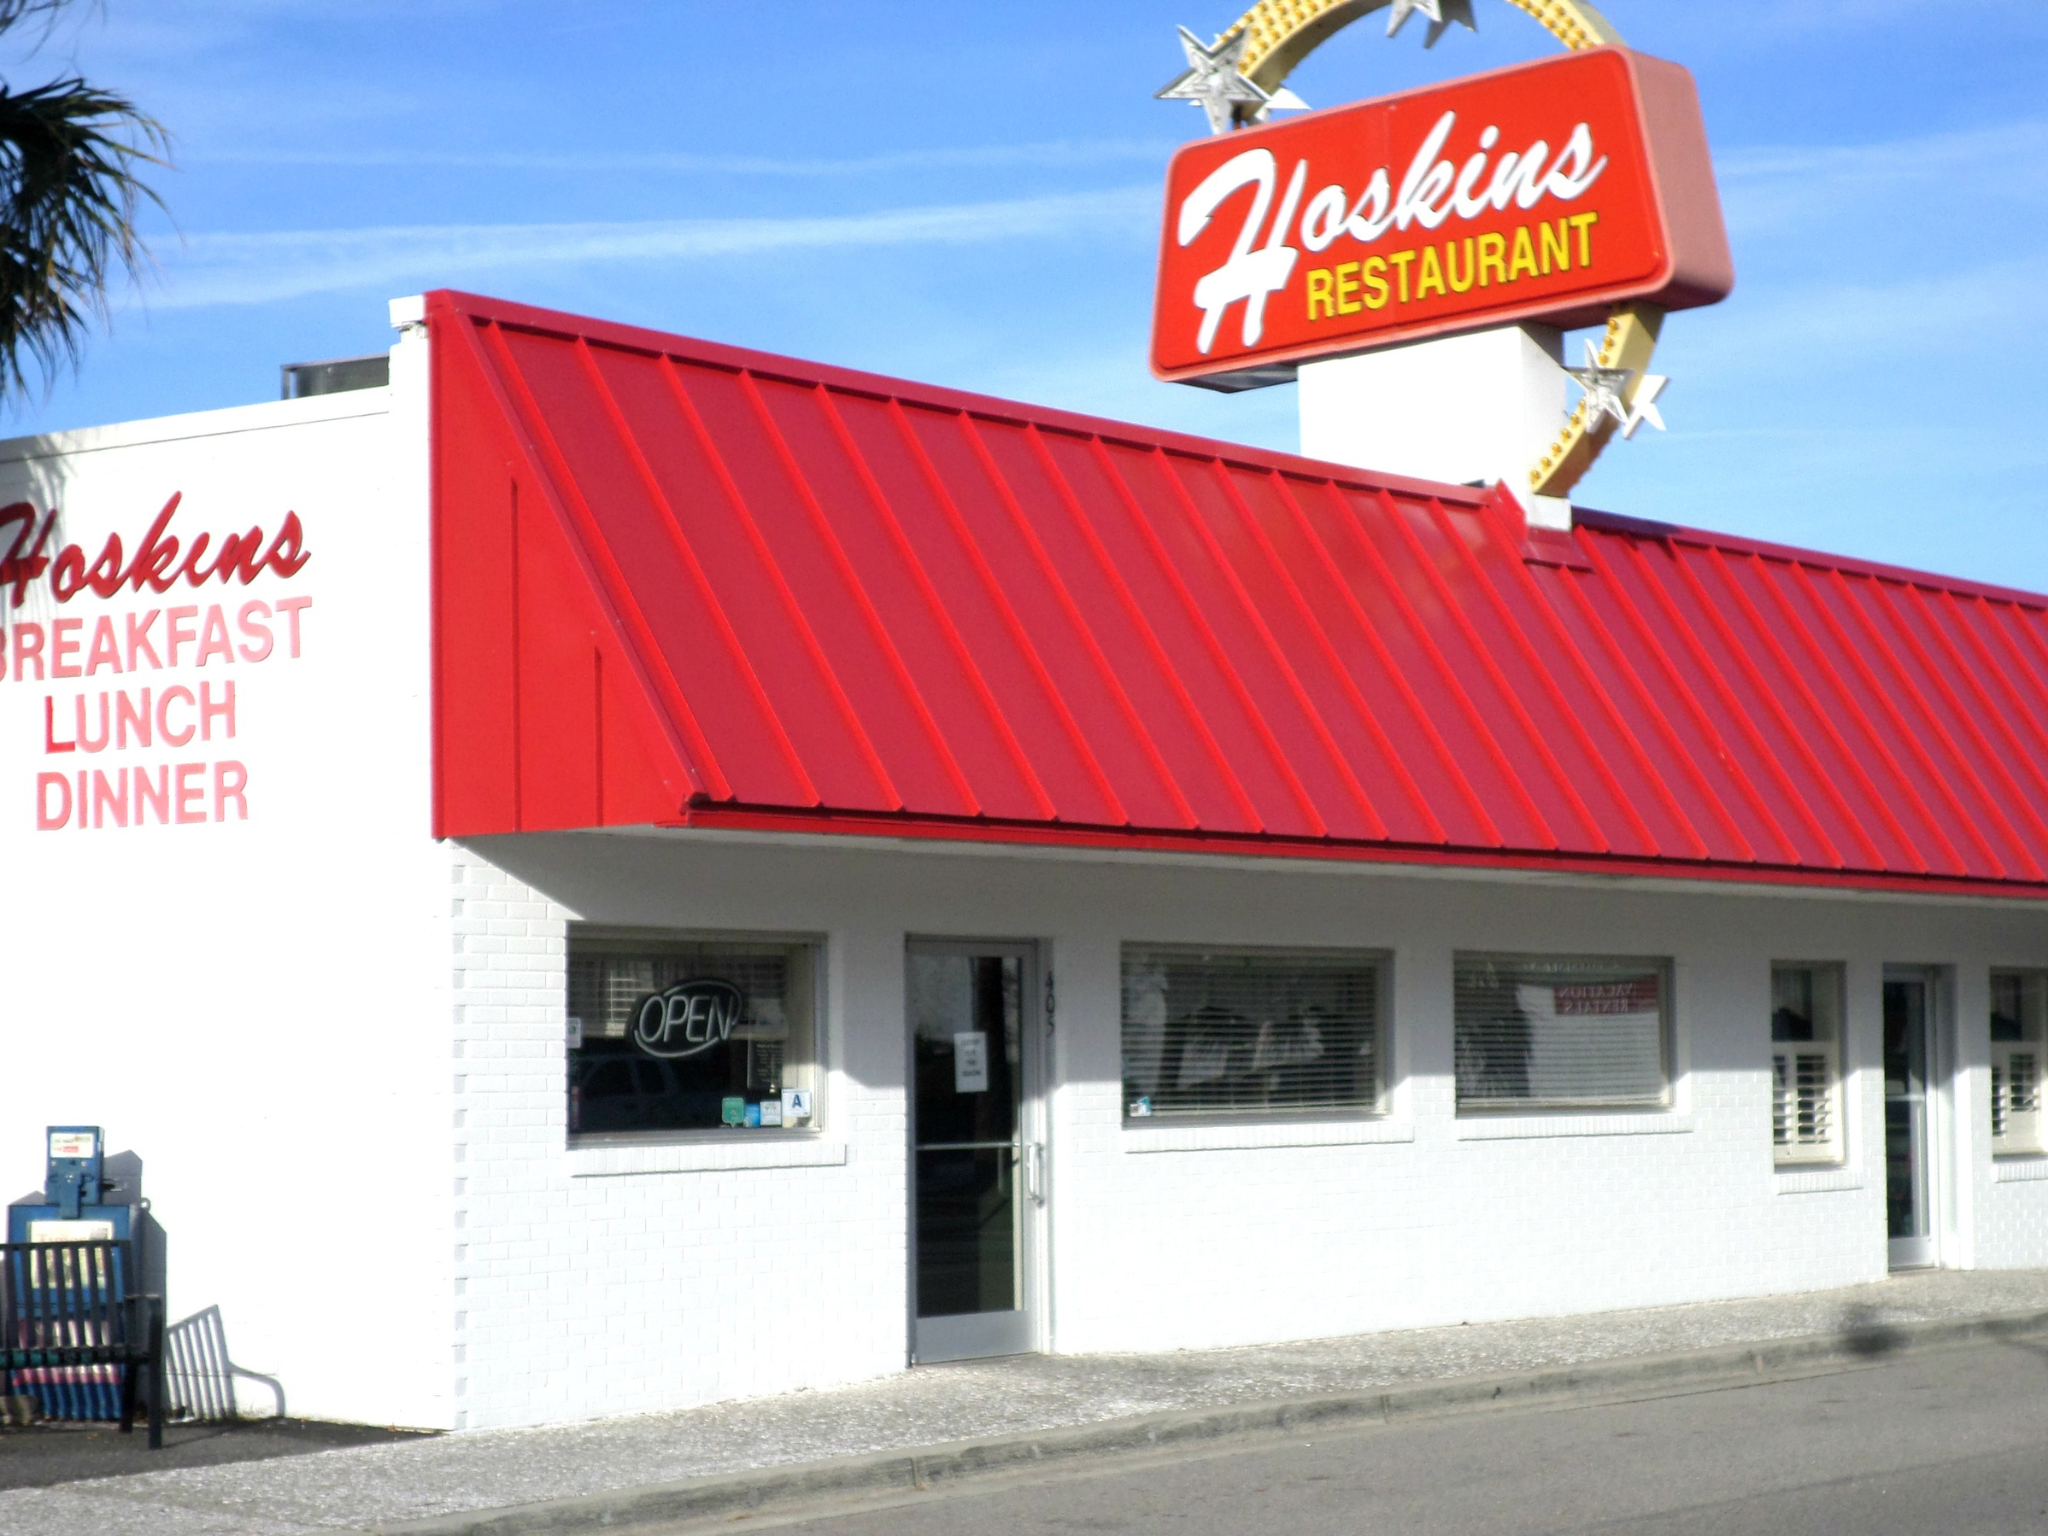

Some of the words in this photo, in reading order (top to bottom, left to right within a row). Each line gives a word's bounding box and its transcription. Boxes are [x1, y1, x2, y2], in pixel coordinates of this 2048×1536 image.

[1178, 110, 1608, 354] Hoskins
[1306, 211, 1599, 321] RESTAURANT
[0, 595, 313, 682] REAKFAST
[44, 680, 236, 755] LUNCH
[36, 760, 249, 831] DINNER
[639, 995, 734, 1043] OPEN
[792, 1094, 802, 1108] A
